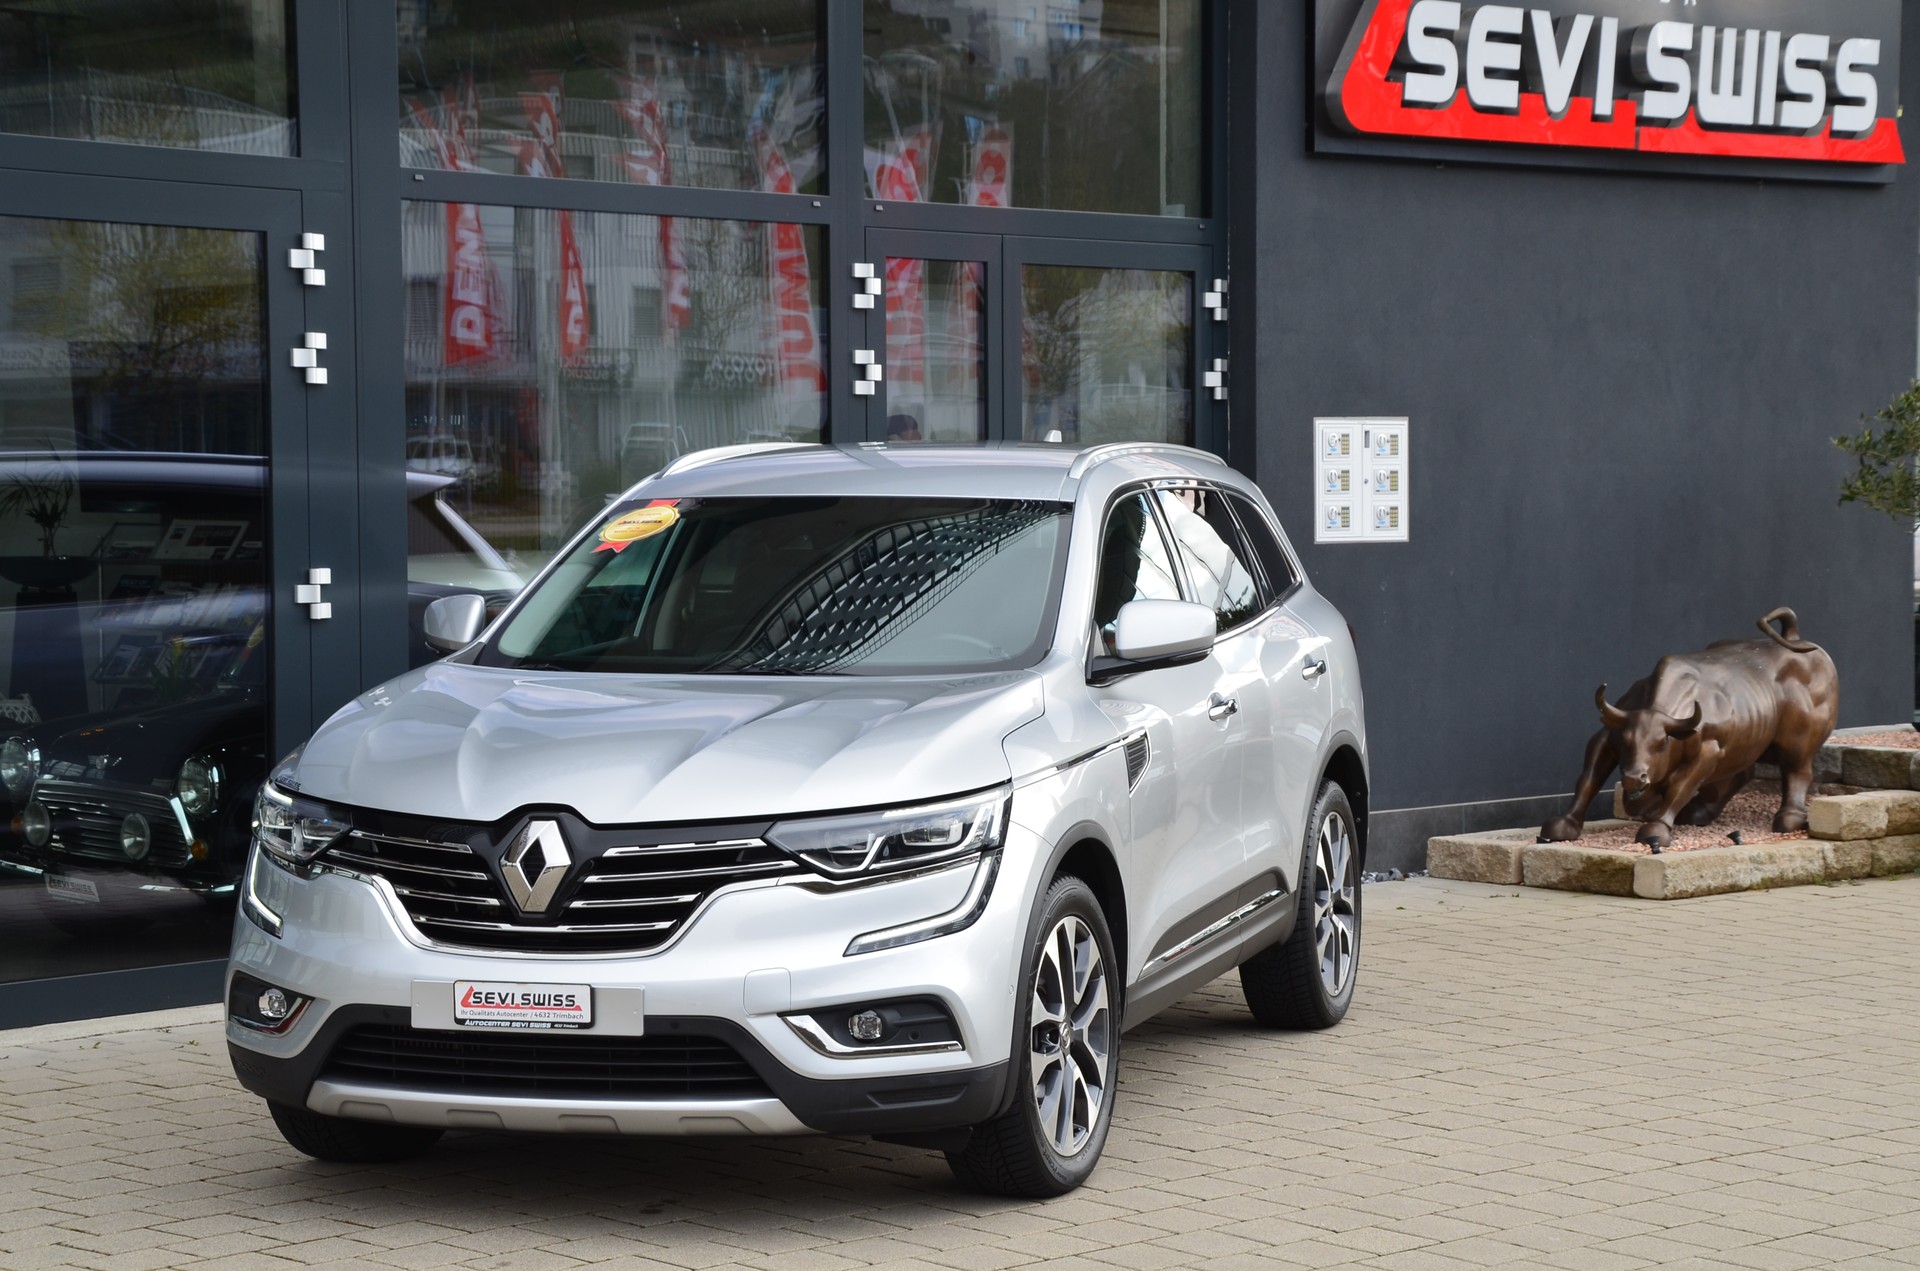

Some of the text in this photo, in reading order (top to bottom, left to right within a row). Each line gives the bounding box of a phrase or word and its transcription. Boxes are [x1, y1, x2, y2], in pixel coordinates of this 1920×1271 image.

[1404, 0, 1881, 132] SEVI SWISS
[472, 991, 576, 1007] SEVI SWISS
[495, 1010, 528, 1018] Autocenter
[552, 1012, 584, 1020] Trimbach
